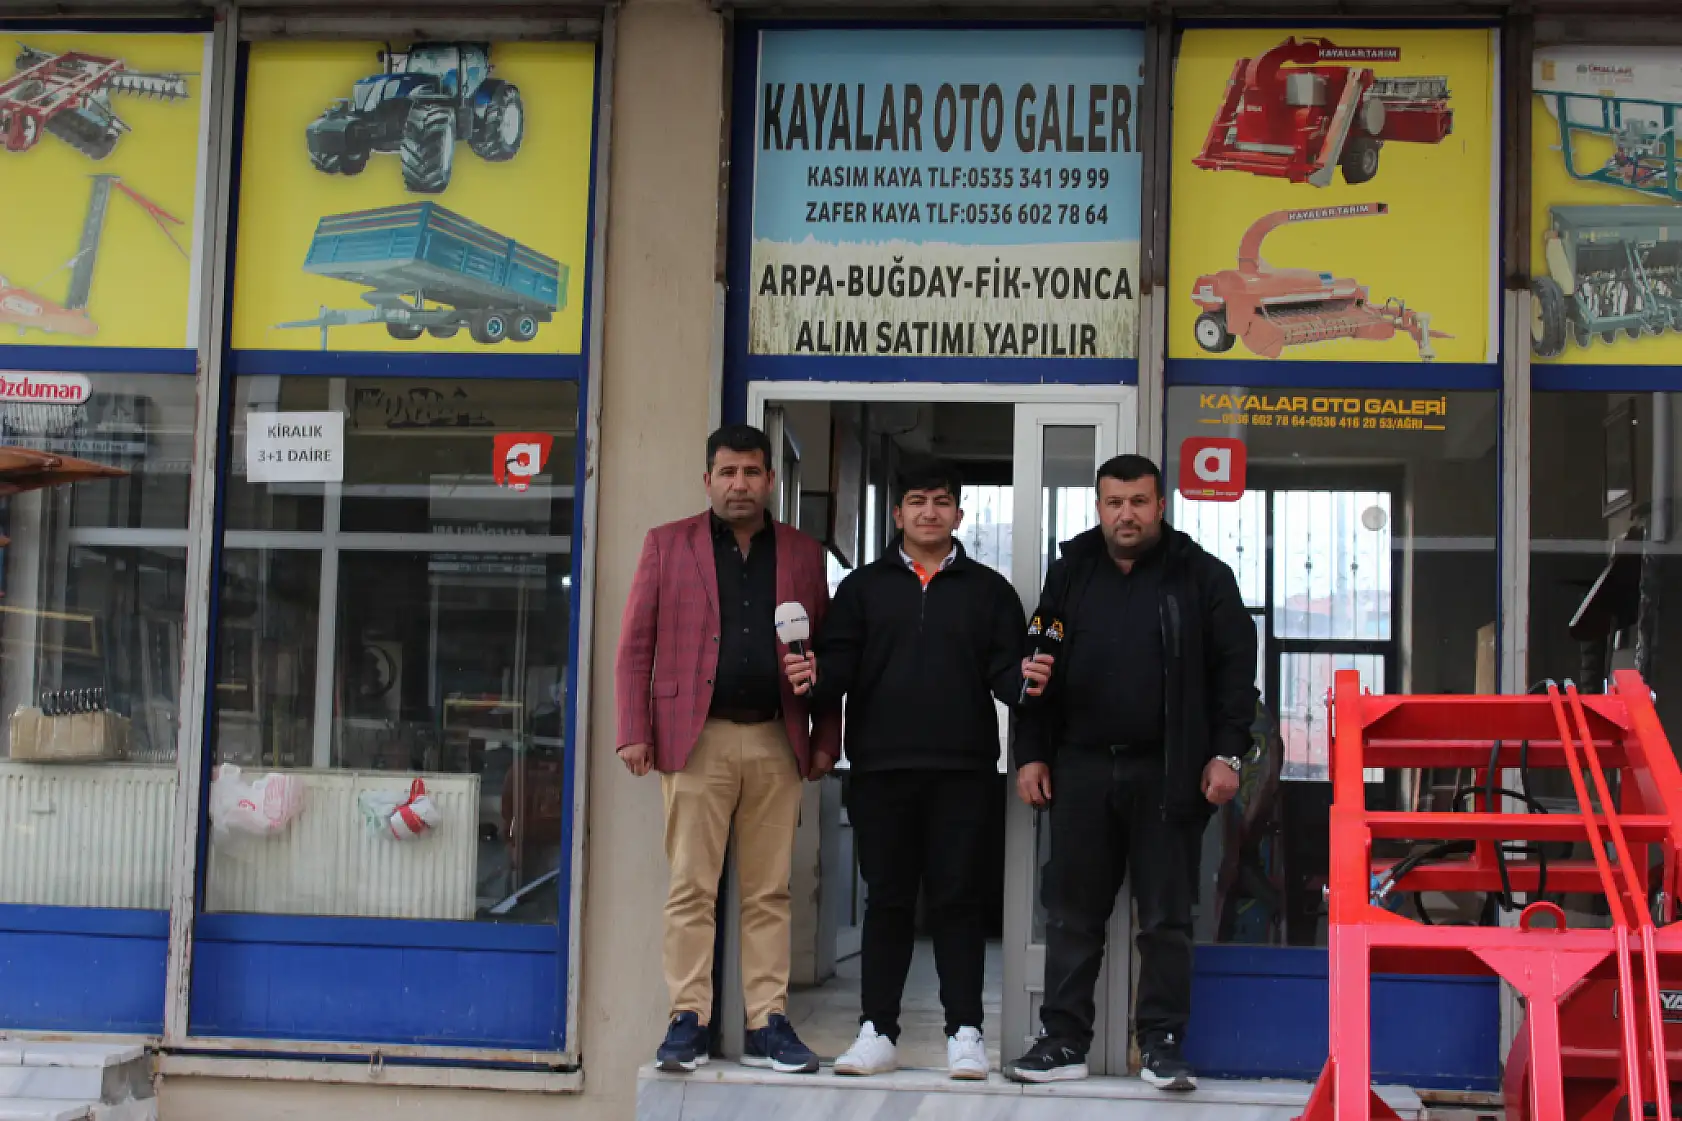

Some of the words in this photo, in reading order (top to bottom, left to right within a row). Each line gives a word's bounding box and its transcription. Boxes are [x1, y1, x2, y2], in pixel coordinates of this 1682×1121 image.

[763, 82, 923, 152] KAYALAR
[934, 82, 1004, 153] OTO
[807, 165, 869, 188] KASIM
[874, 166, 923, 188] KAYA
[929, 167, 1014, 189] TLF:0535
[1019, 168, 1053, 189] 341
[1059, 168, 1082, 189] 99
[1087, 168, 1110, 189] 99
[806, 202, 867, 223] ZAFER
[872, 202, 921, 223] KAYA
[927, 203, 1013, 224] TLF:0536
[1017, 204, 1052, 225] 602
[1058, 204, 1080, 225] 78
[1086, 204, 1108, 225] 64
[759, 255, 1133, 300] ARPA-BUĞDAY-FİK-YONCA
[796, 321, 867, 352] ALIM
[876, 321, 975, 355] SATIMI
[984, 323, 1097, 356] YAPILIR
[1200, 393, 1308, 413] KAYALAR
[1312, 398, 1361, 413] OTO
[1365, 396, 1446, 416] GALERİ
[267, 422, 323, 439] KİRALIK
[1222, 413, 1249, 425] 0536
[1251, 414, 1273, 426] 602
[1276, 415, 1289, 426] 78
[258, 449, 283, 462] 3+1
[287, 446, 332, 462] DAİRE
